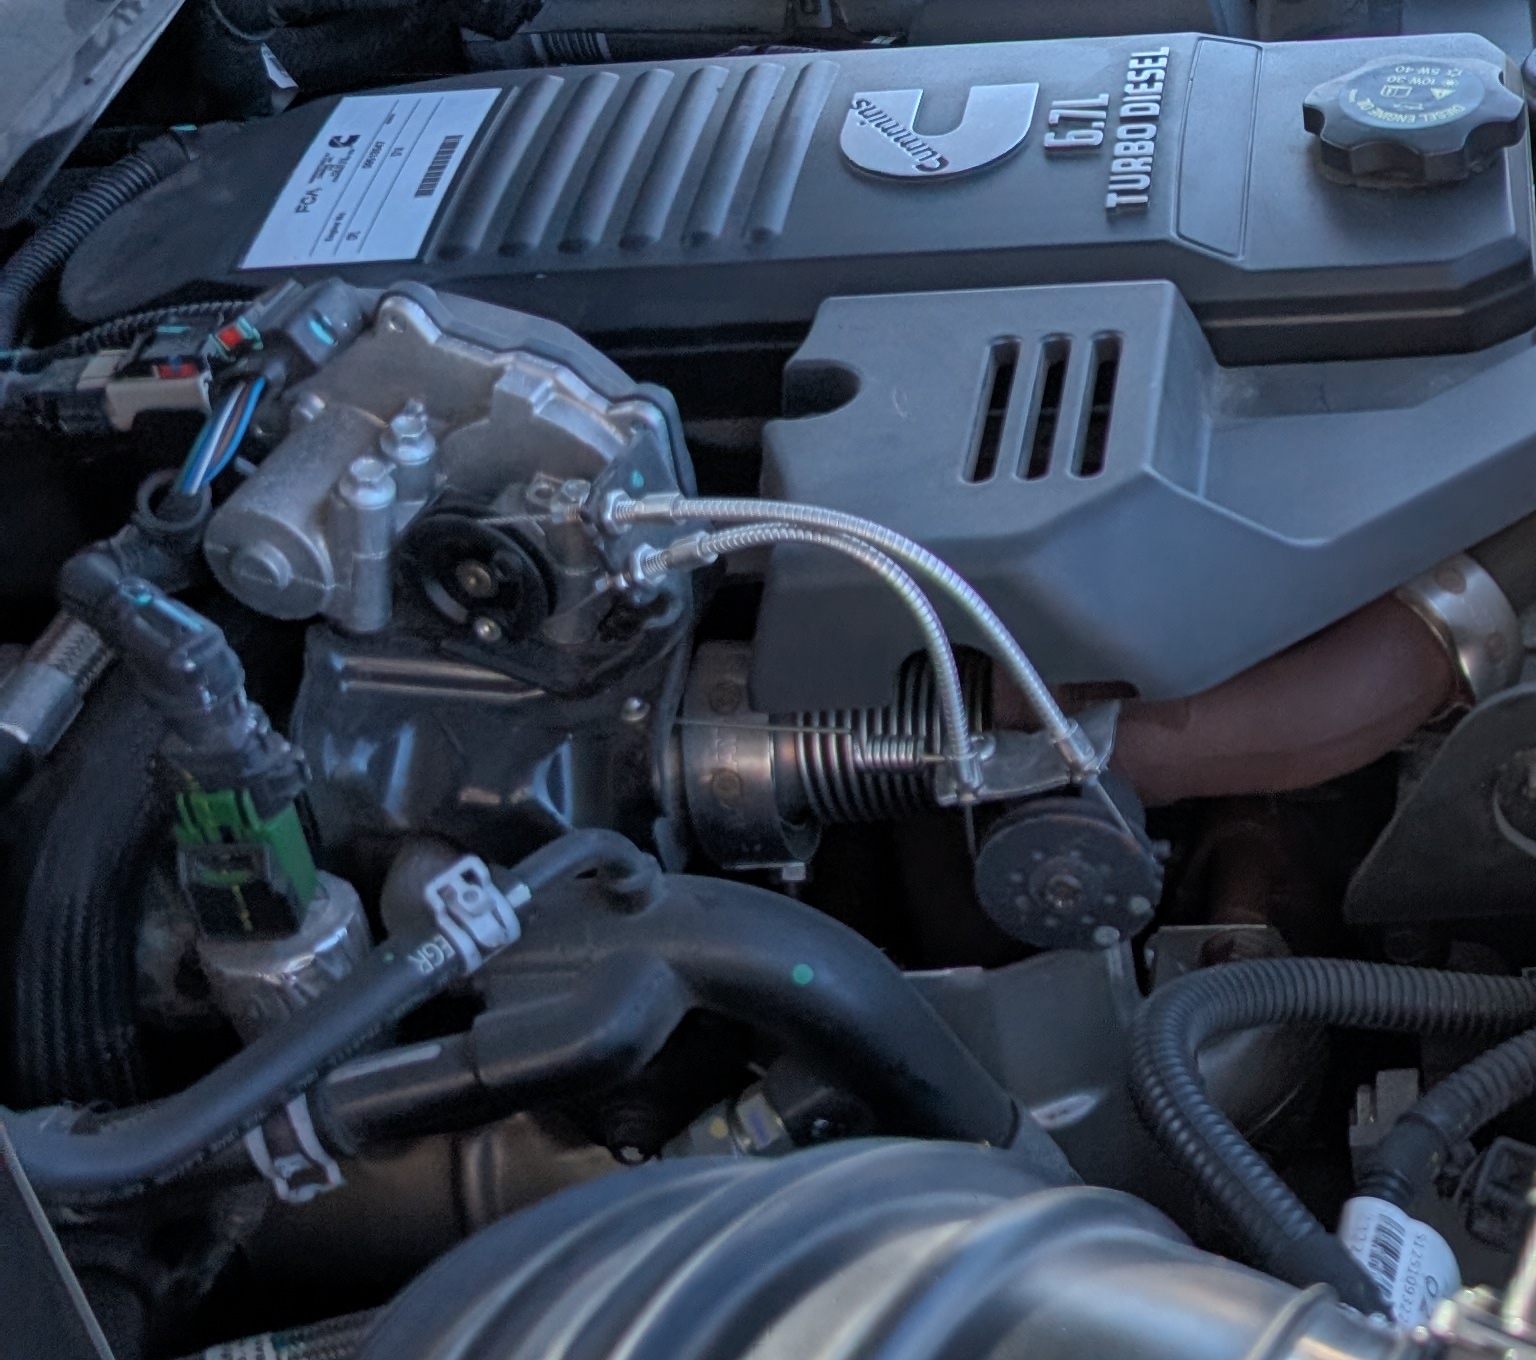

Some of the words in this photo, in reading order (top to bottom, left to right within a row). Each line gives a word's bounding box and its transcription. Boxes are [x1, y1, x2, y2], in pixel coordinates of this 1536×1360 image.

[1118, 45, 1171, 119] DIESEL
[851, 98, 950, 173] Cummins
[1042, 92, 1110, 148] 6.7L
[1105, 122, 1158, 210] TURBO
[407, 934, 456, 975] EGR
